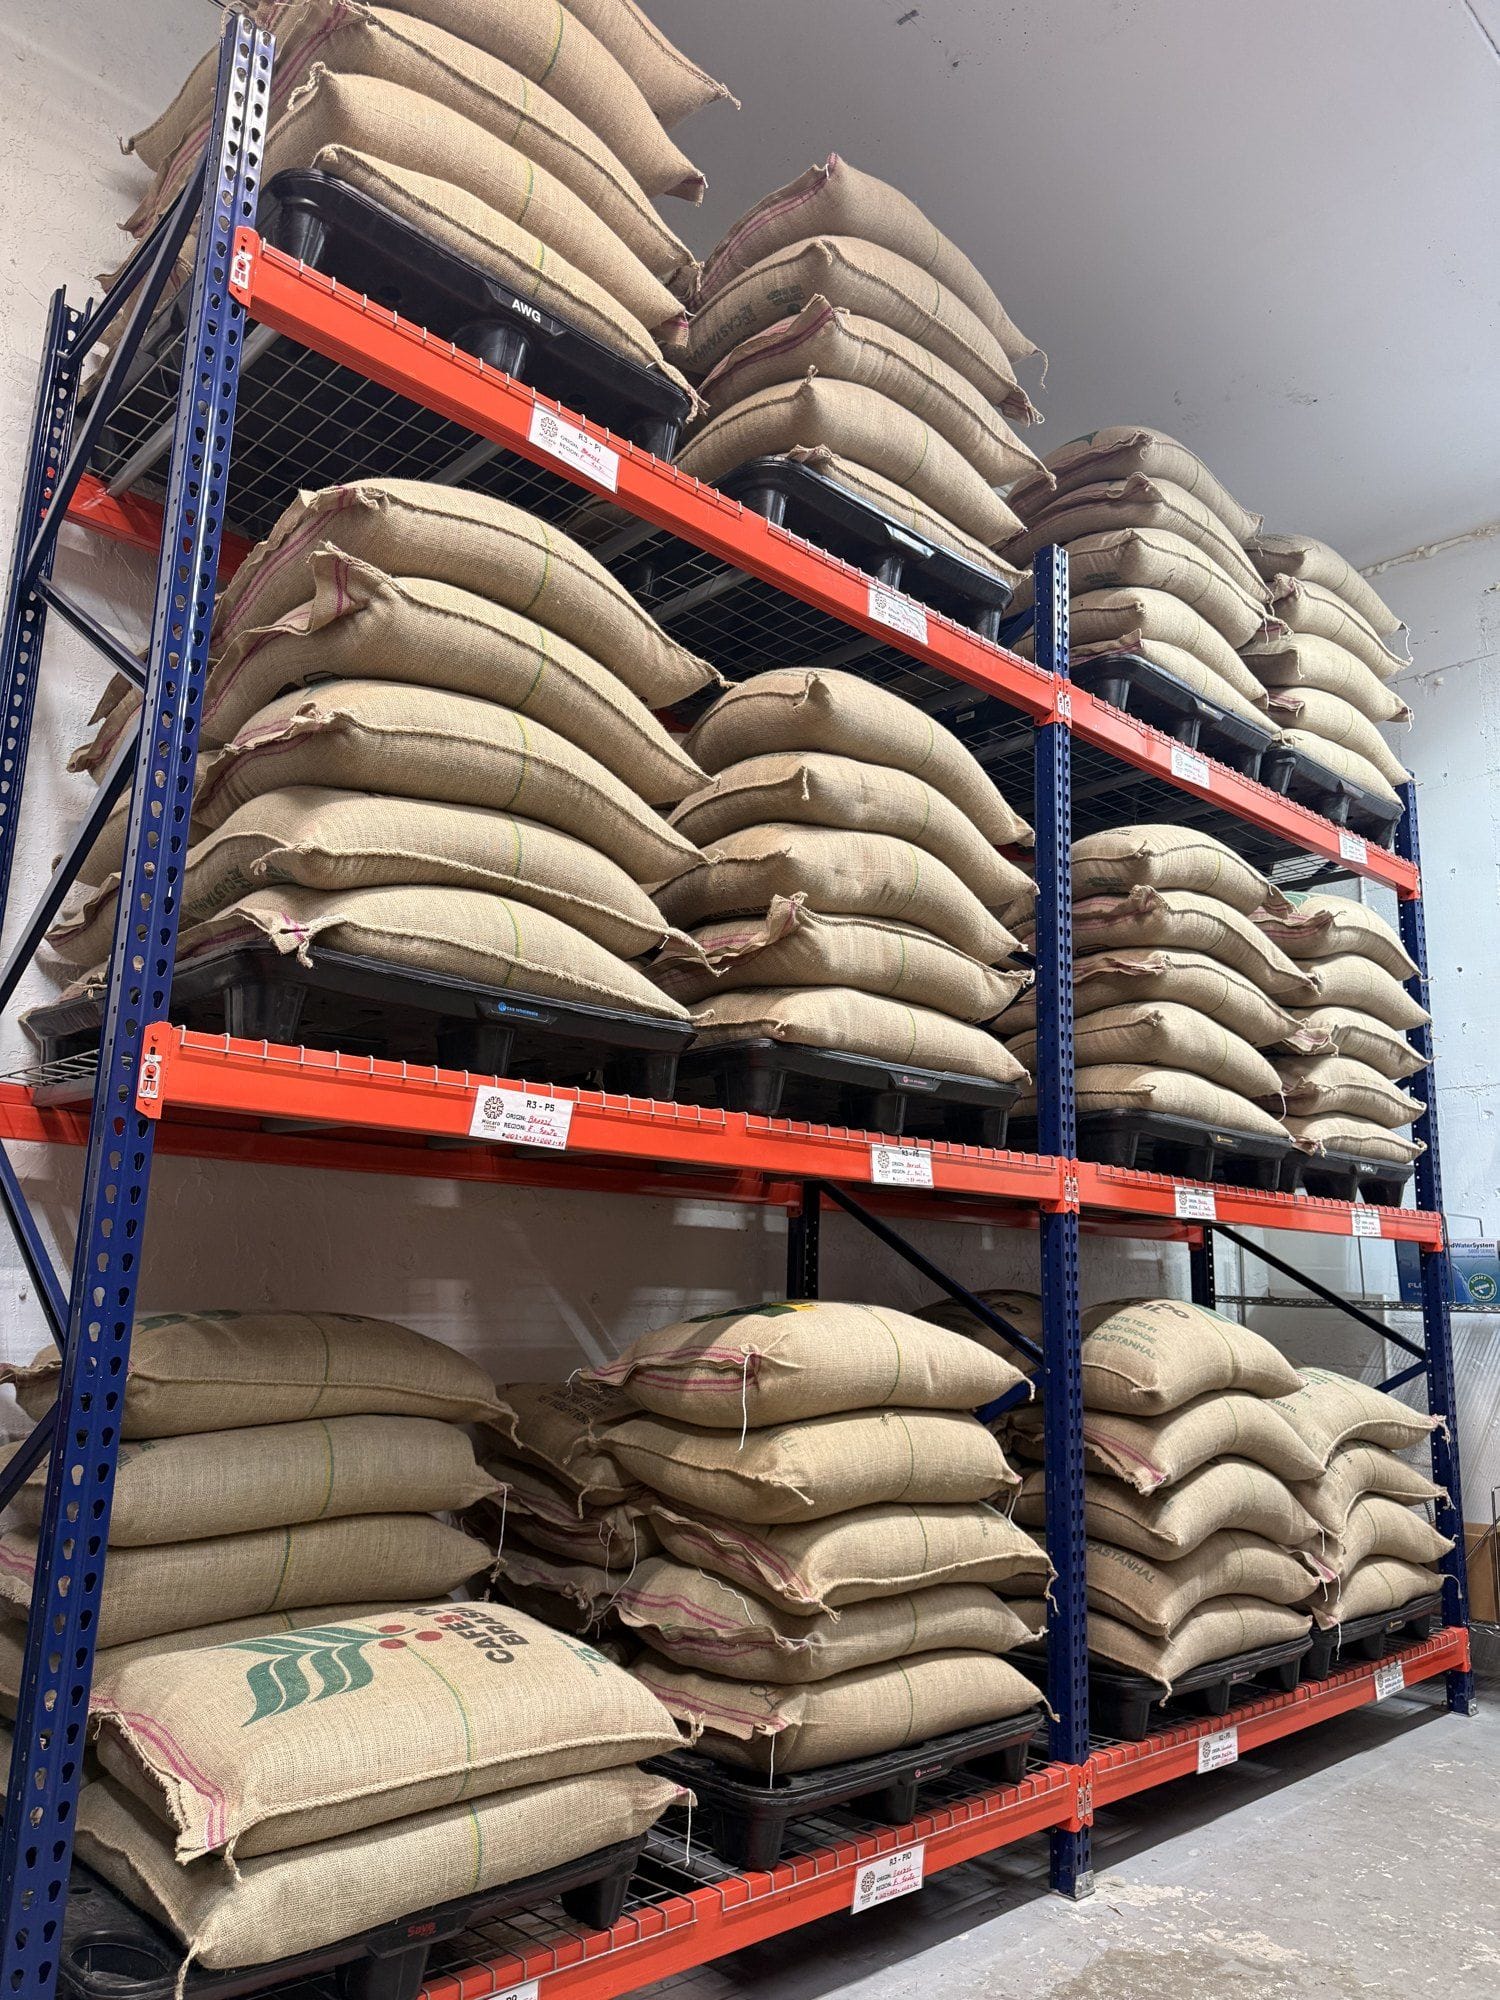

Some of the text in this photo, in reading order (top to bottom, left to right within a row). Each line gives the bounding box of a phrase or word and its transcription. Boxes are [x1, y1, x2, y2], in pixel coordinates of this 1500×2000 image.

[512, 299, 541, 323] AWG
[526, 1100, 537, 1109] R3
[545, 1103, 555, 1112] P5
[450, 1606, 530, 1646] BRASIL
[434, 1614, 515, 1664] CAFÉS
[889, 1857, 897, 1866] R3
